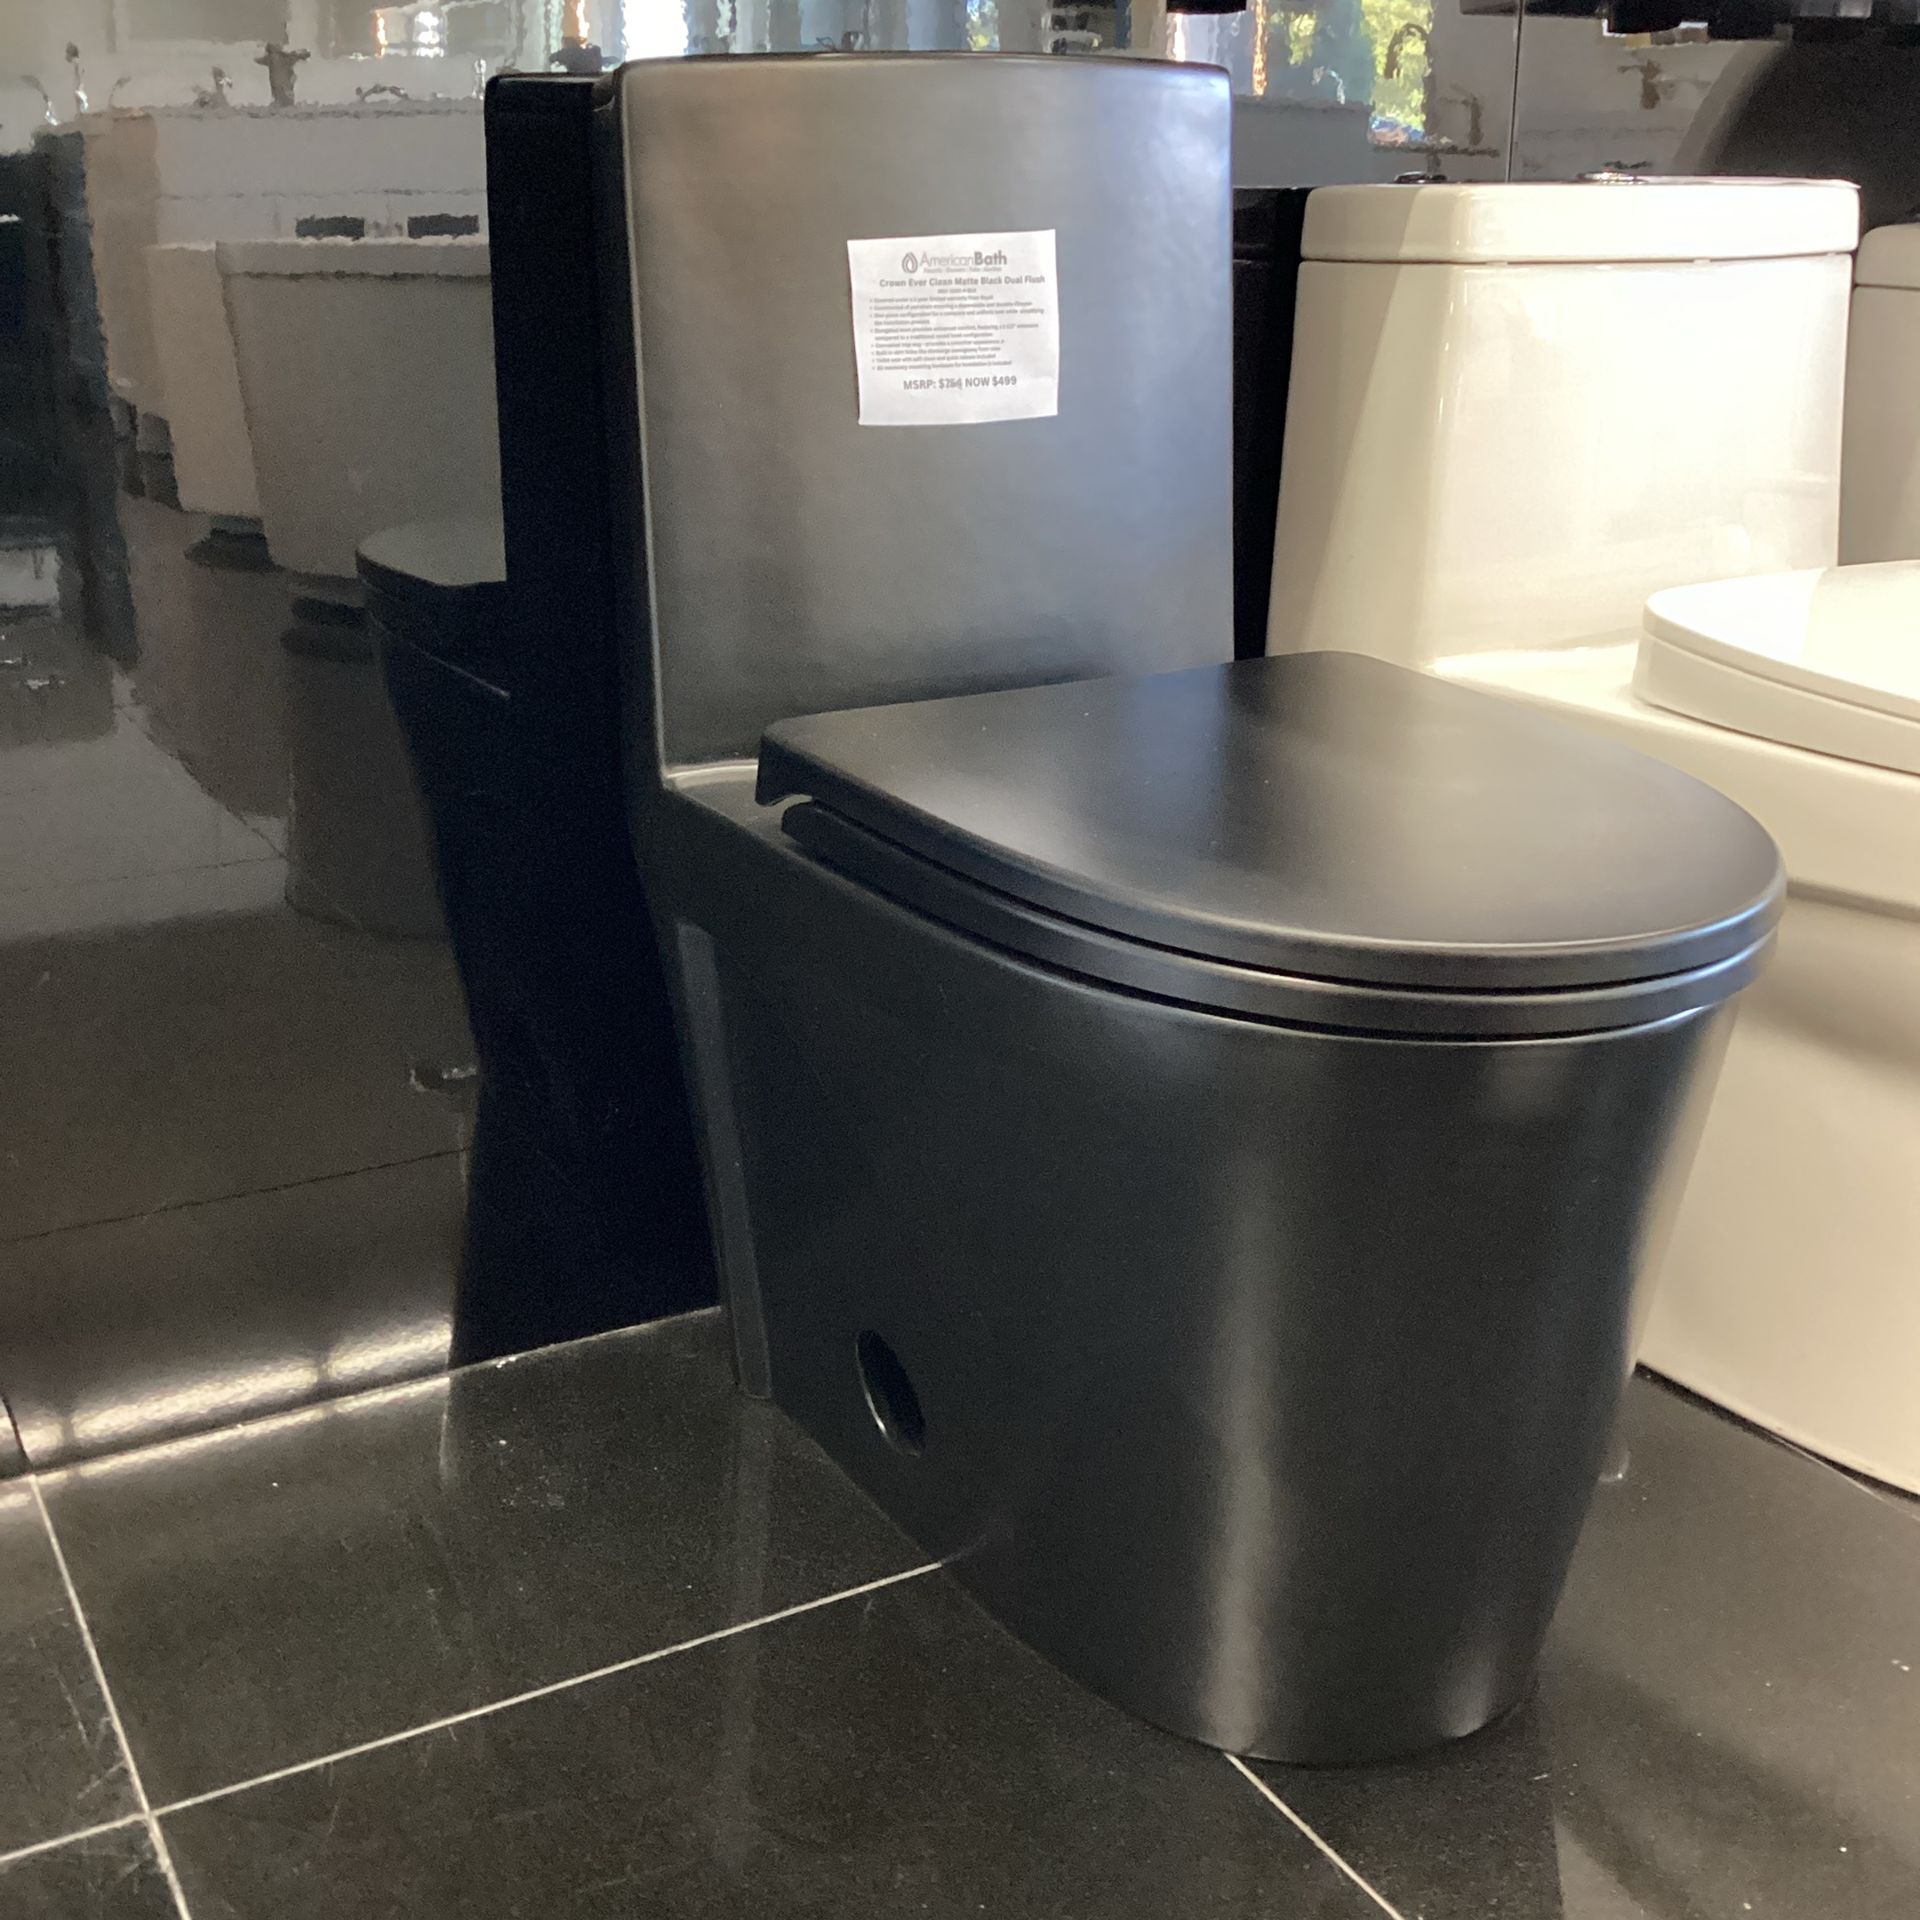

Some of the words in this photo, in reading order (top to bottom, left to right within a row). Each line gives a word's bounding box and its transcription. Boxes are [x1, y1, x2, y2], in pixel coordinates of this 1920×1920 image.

[879, 279, 907, 287] Crown
[908, 278, 927, 286] Ever
[929, 278, 953, 286] Clean
[954, 276, 979, 285] Matte
[980, 276, 1002, 285] Black
[1004, 275, 1023, 284] Dual
[1024, 275, 1045, 283] Flush
[903, 379, 937, 390] MSRP:
[965, 376, 990, 387] NOW
[992, 375, 1018, 387] $499
